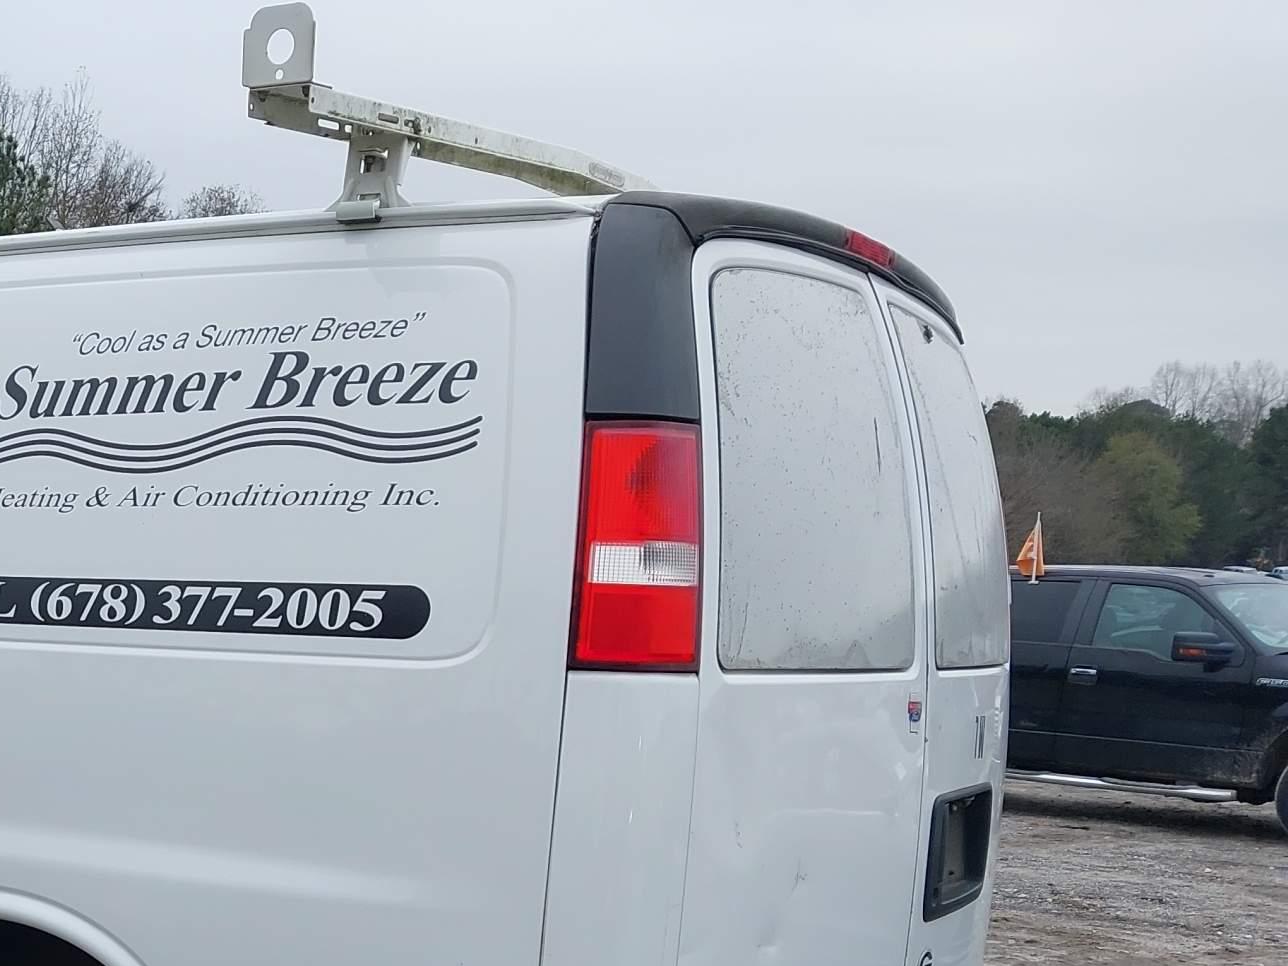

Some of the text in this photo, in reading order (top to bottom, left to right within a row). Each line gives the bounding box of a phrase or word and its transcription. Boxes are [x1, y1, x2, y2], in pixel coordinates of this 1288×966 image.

[137, 331, 167, 352] as
[172, 331, 189, 350] a
[196, 324, 308, 349] Summer
[245, 350, 478, 410] Breeze
[86, 487, 111, 508] &
[116, 485, 166, 508] Air
[173, 483, 372, 513] Conditioning
[379, 483, 440, 506] Inc.
[31, 582, 146, 625] (678)
[153, 585, 387, 631] 377-2005
